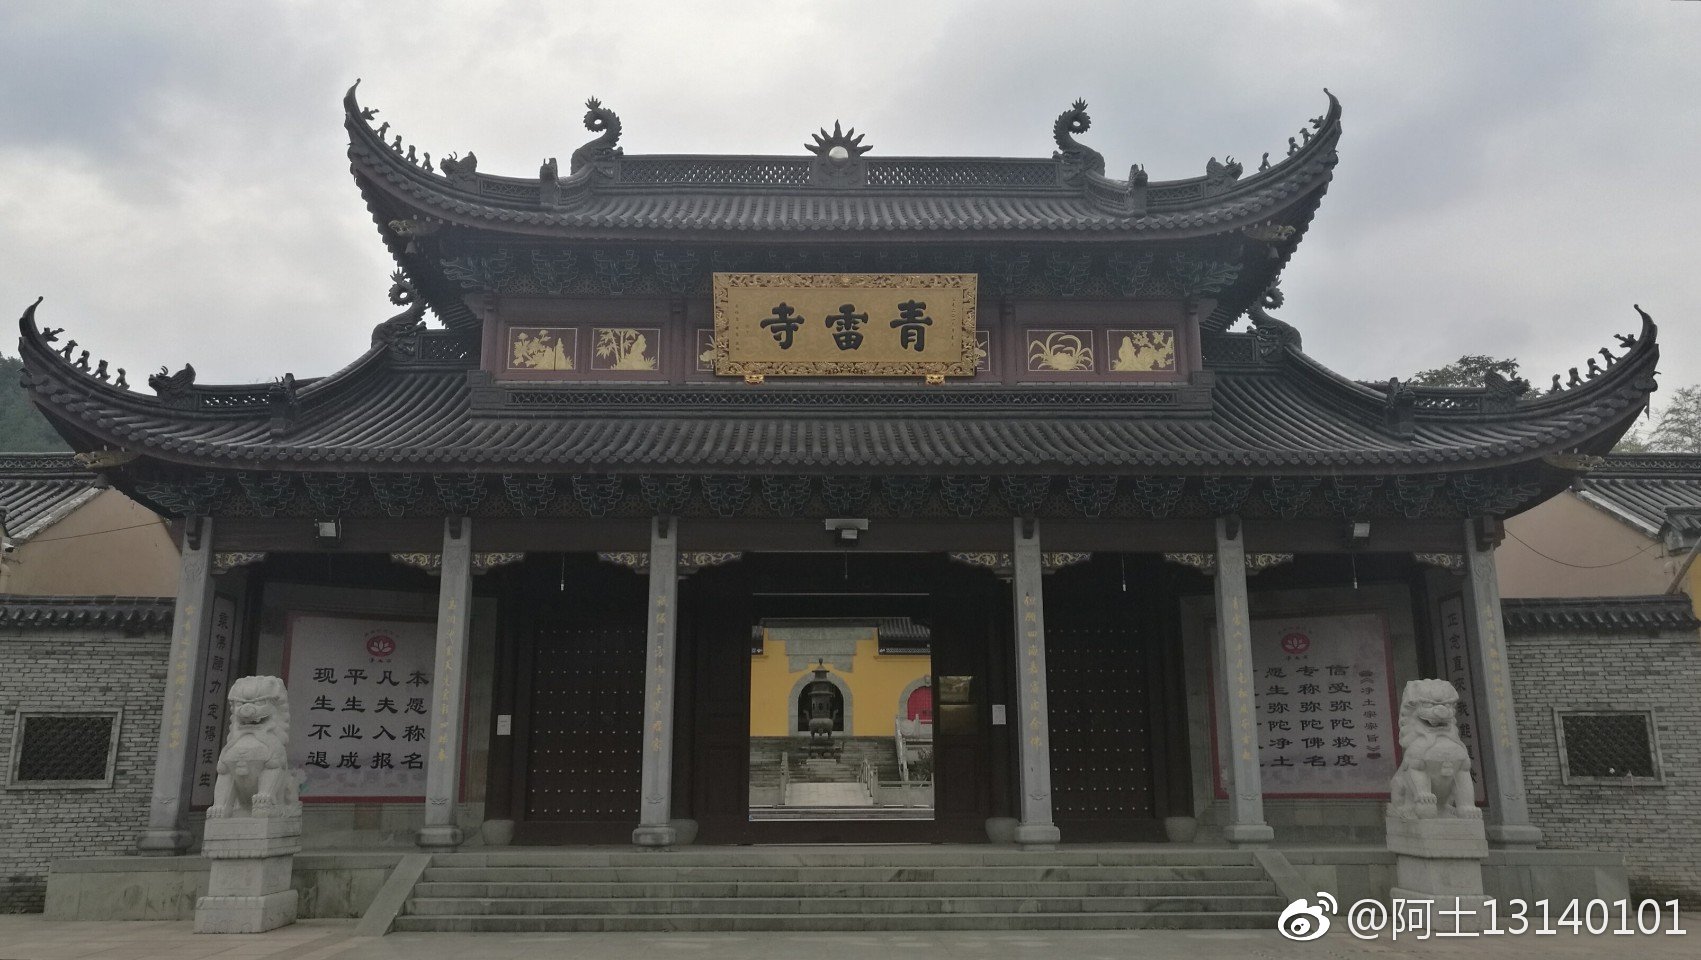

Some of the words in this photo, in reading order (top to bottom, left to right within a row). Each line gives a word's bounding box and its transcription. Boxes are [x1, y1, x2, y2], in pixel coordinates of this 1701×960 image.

[760, 299, 933, 352] 青雷寺
[305, 667, 338, 769] 现生不退
[336, 669, 368, 769] 平生业成
[370, 670, 399, 769] 凡夫入报
[401, 671, 429, 769] 本愿称名
[1264, 667, 1294, 767] 愿生弥陀净土
[1296, 665, 1326, 766] 专称弥陀佛名
[1325, 664, 1358, 767] 信受弥陀救度
